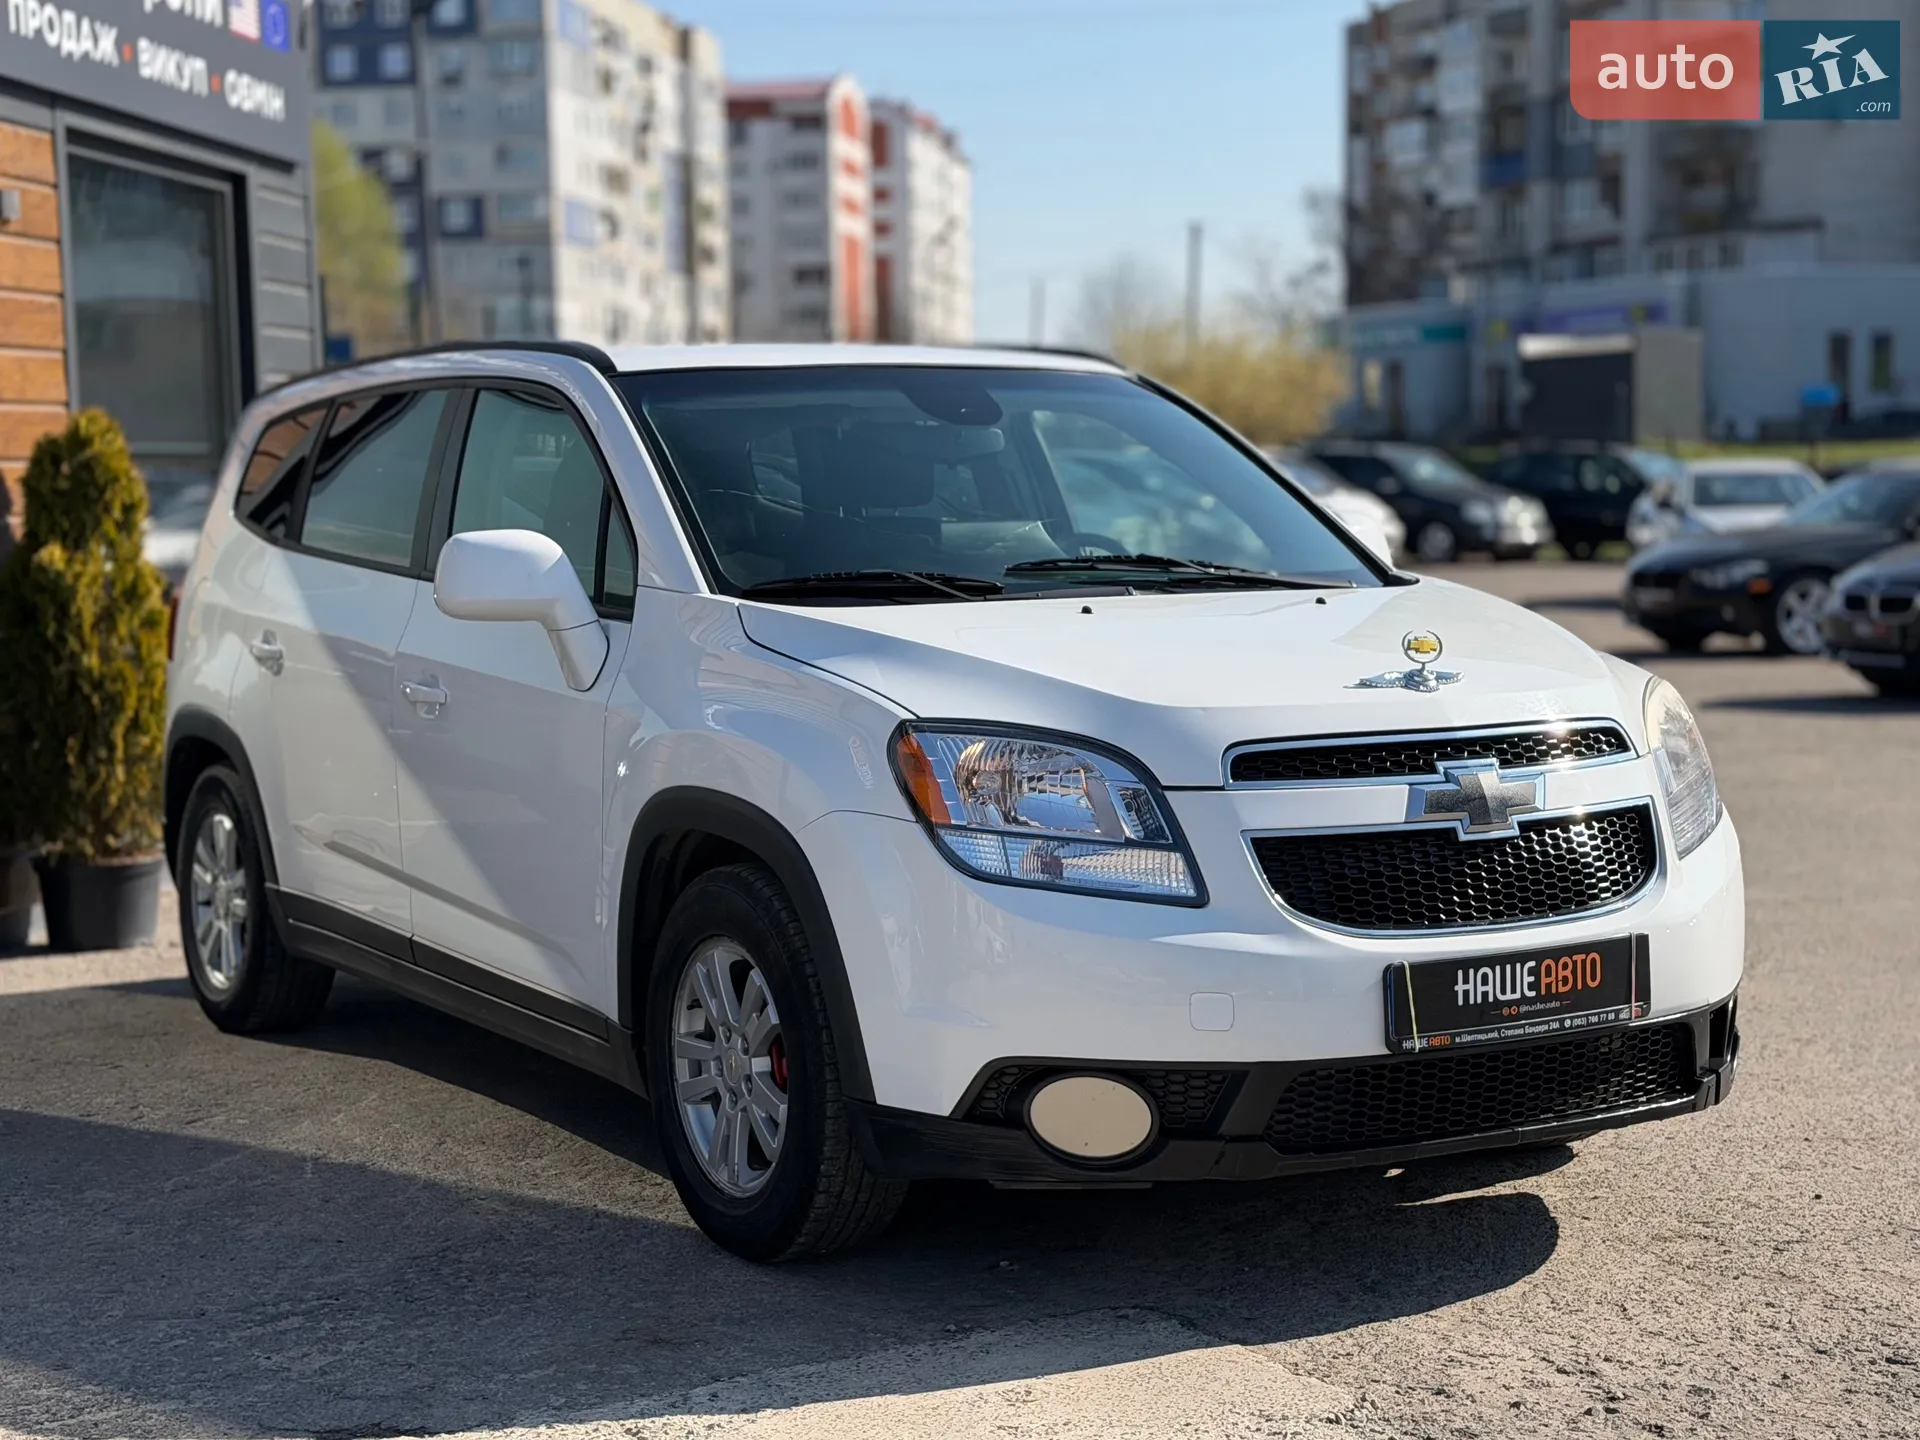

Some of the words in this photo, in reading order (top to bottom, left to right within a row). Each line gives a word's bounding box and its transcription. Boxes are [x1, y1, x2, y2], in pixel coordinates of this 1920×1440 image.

[8, 0, 120, 68] ПРОДАЖ
[136, 36, 209, 98] ВИКУП
[1454, 960, 1536, 1006] НАШЕ
[1540, 952, 1601, 995] АВТО
[1429, 1035, 1451, 1046] АВТО
